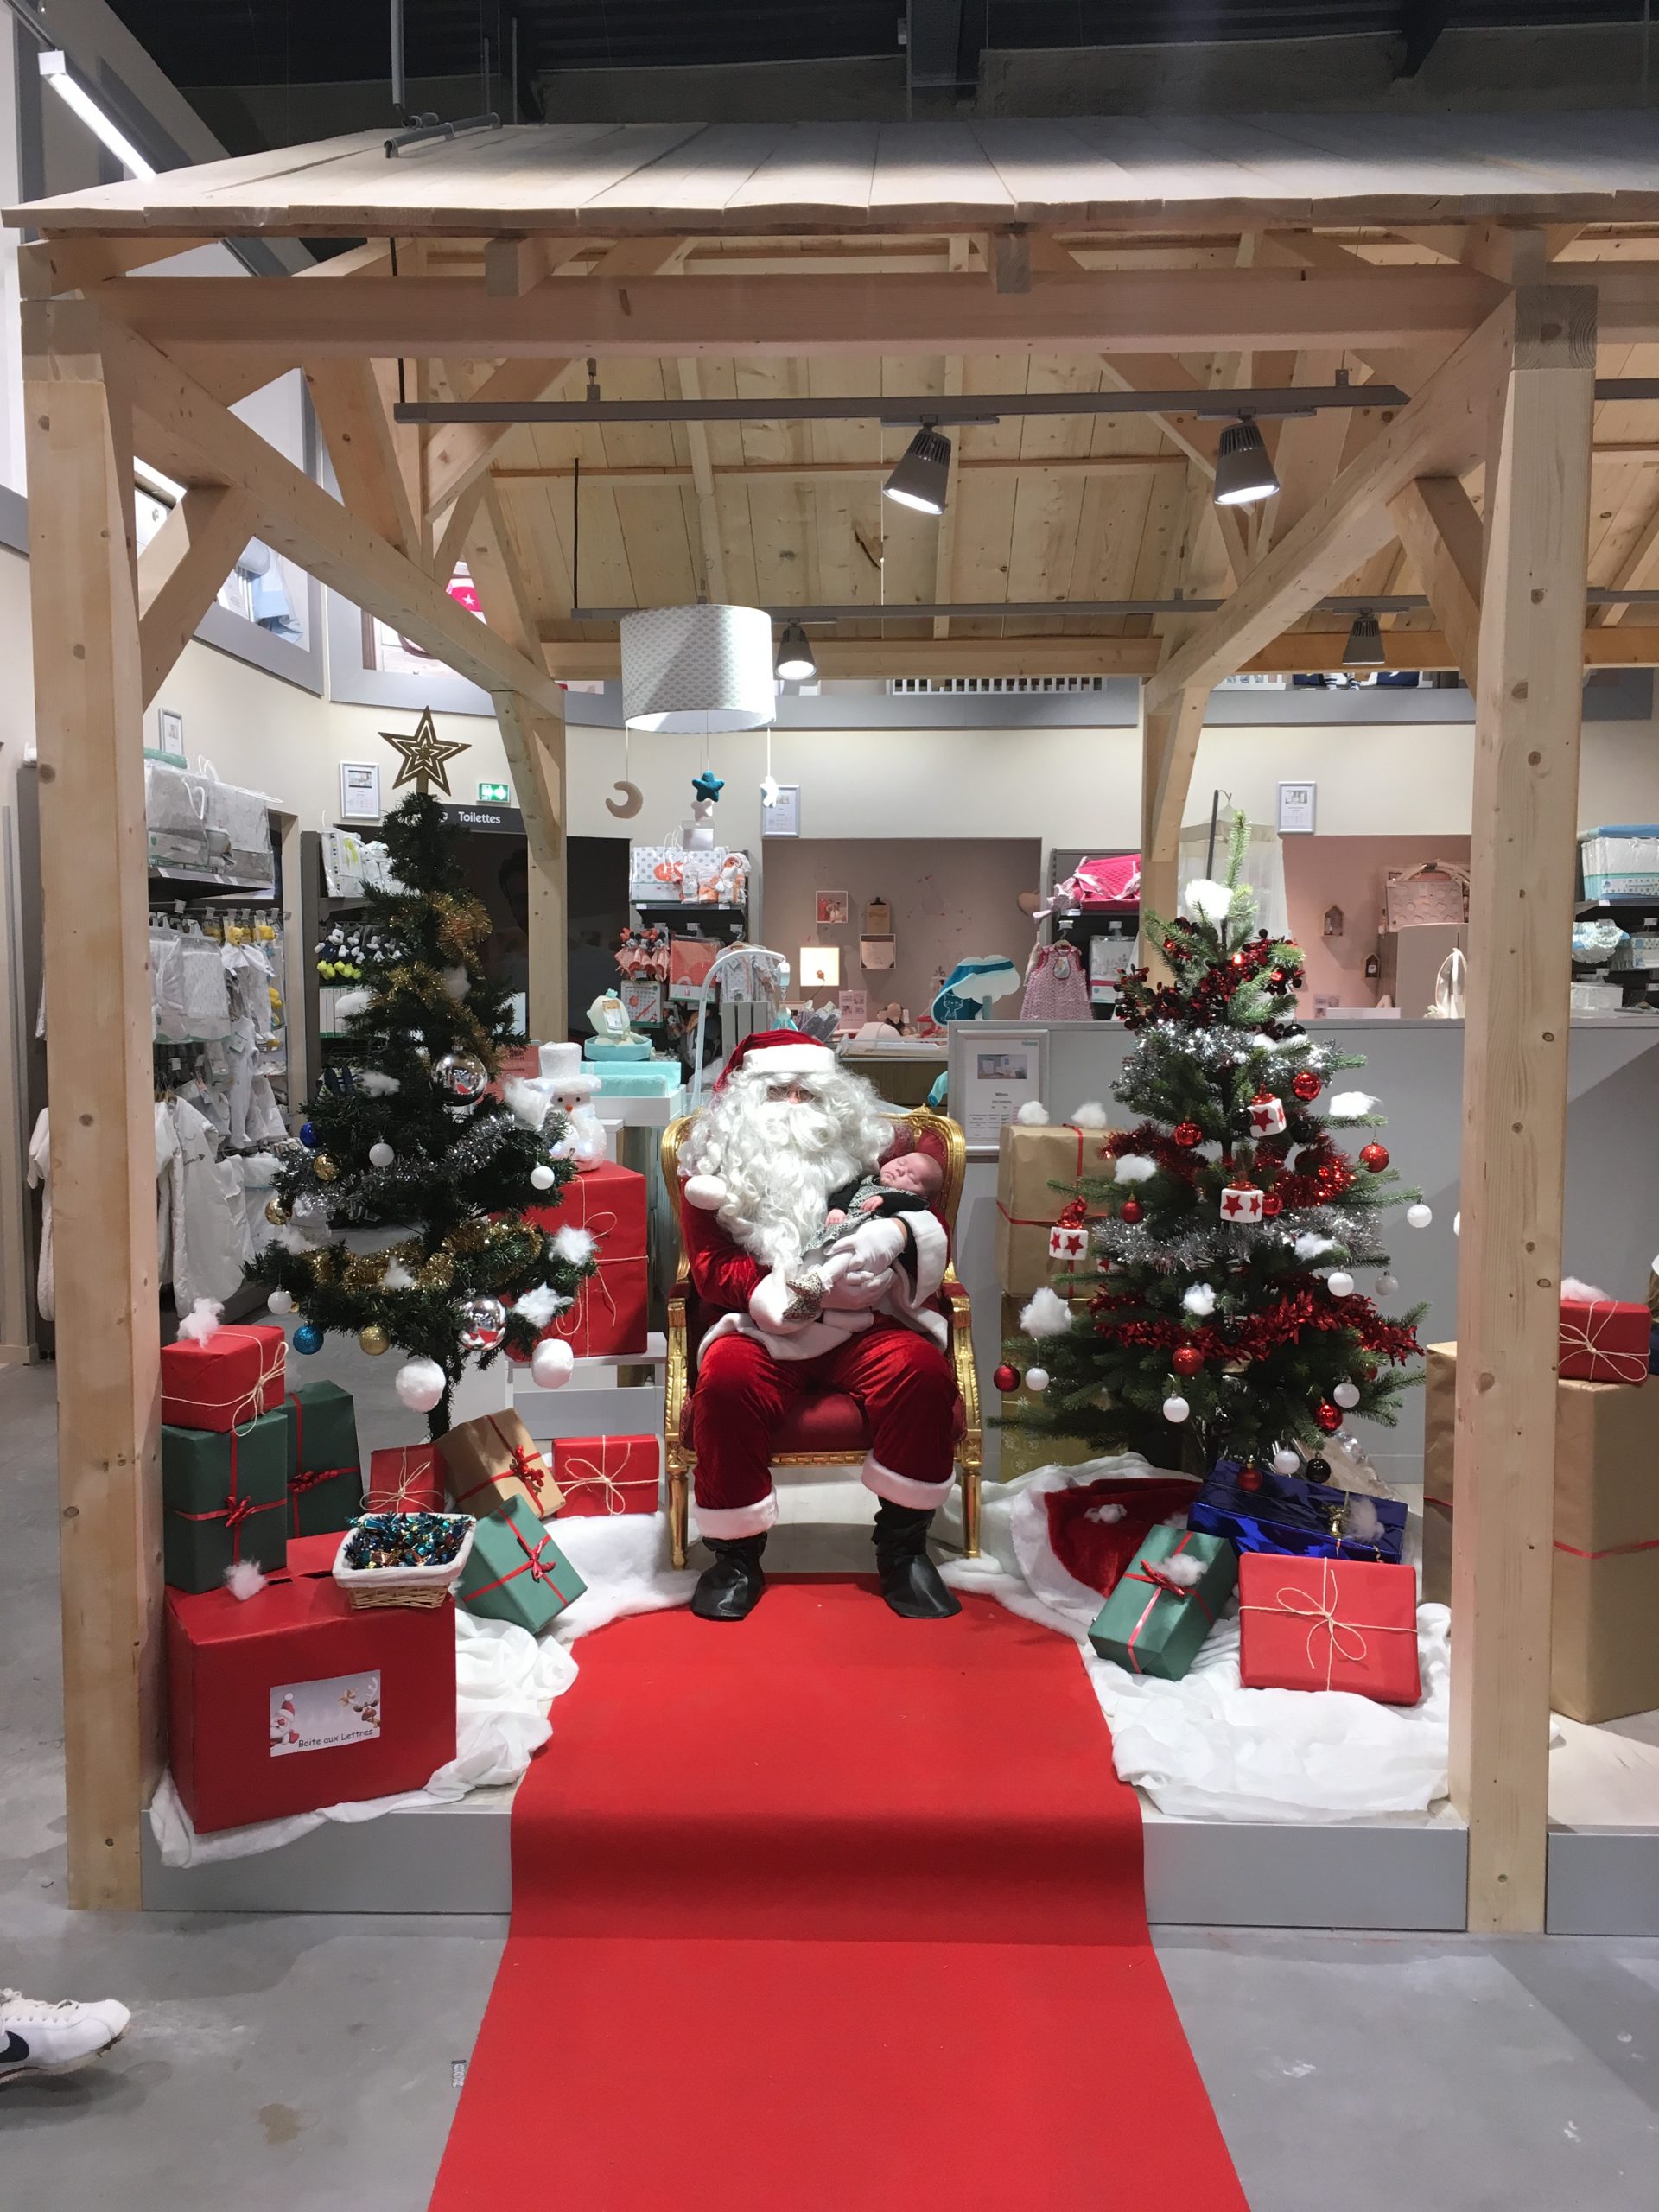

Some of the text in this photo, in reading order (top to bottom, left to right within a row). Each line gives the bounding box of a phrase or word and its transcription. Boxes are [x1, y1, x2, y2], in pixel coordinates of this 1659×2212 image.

[458, 811, 501, 824] Toilettes
[323, 1735, 339, 1744] aux
[340, 1729, 373, 1741] Lettres
